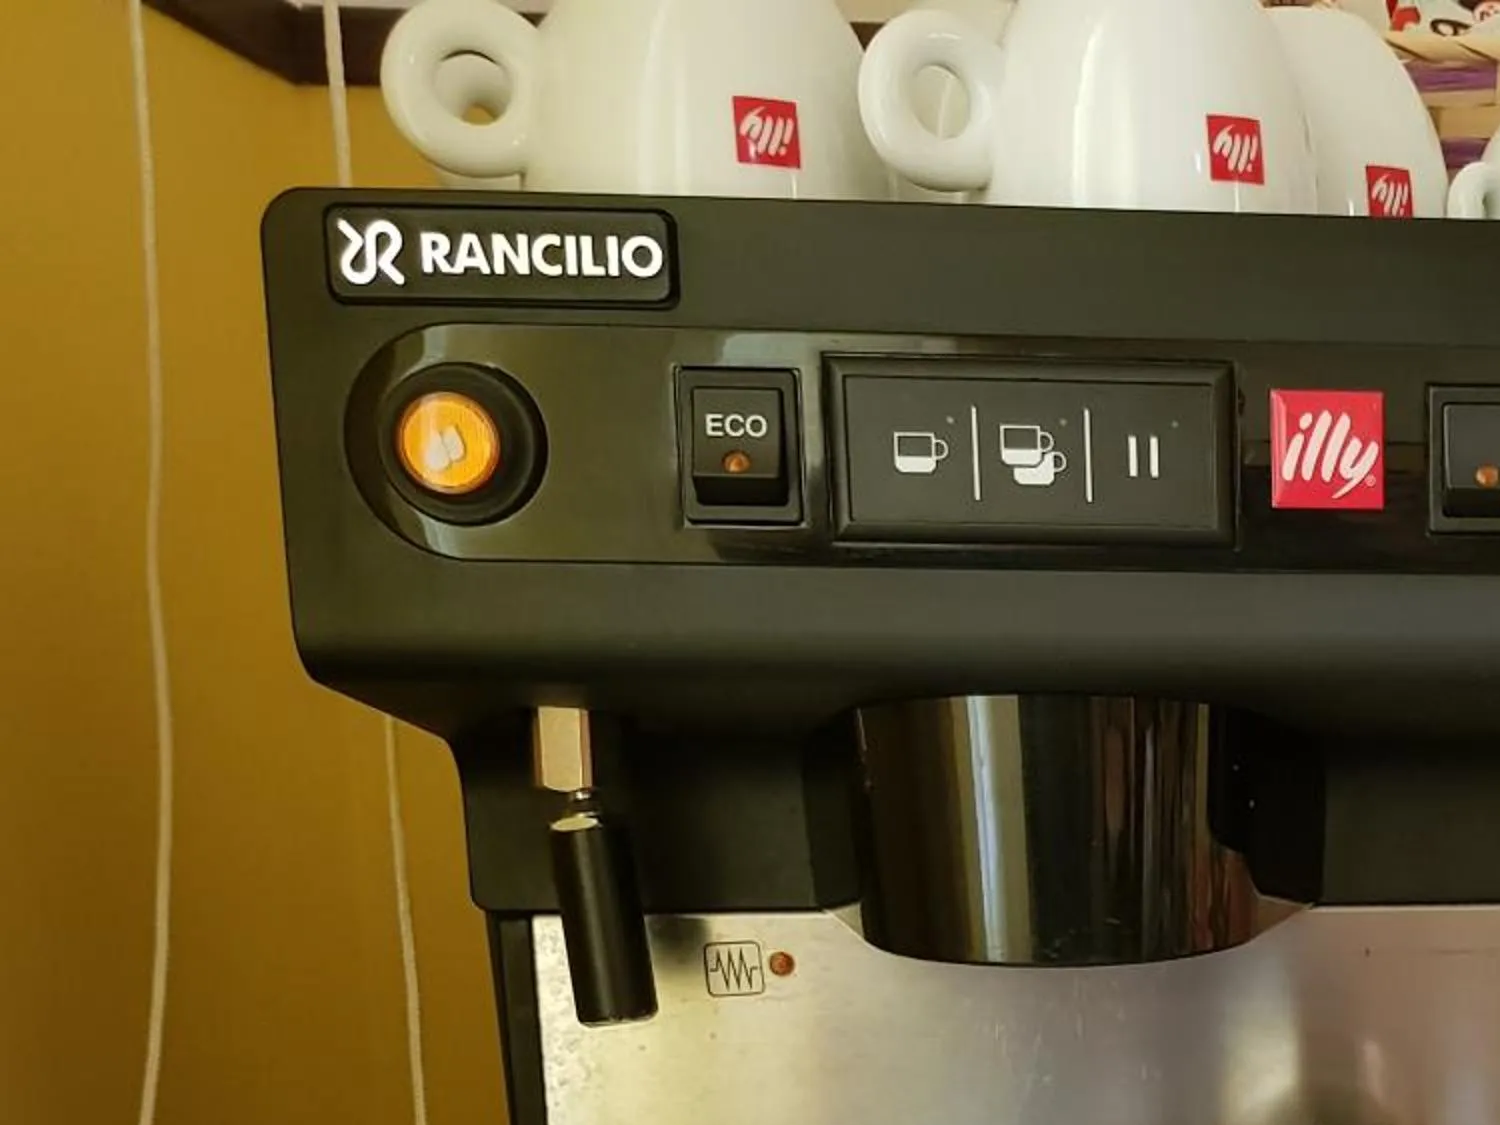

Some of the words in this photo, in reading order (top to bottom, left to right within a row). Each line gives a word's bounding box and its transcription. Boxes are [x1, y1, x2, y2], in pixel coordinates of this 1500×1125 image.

[739, 104, 795, 158] illy
[1213, 124, 1260, 173] illy
[1371, 172, 1409, 217] illy
[419, 231, 664, 278] RANCILIO
[704, 413, 768, 438] ECO
[1280, 409, 1379, 499] illy
